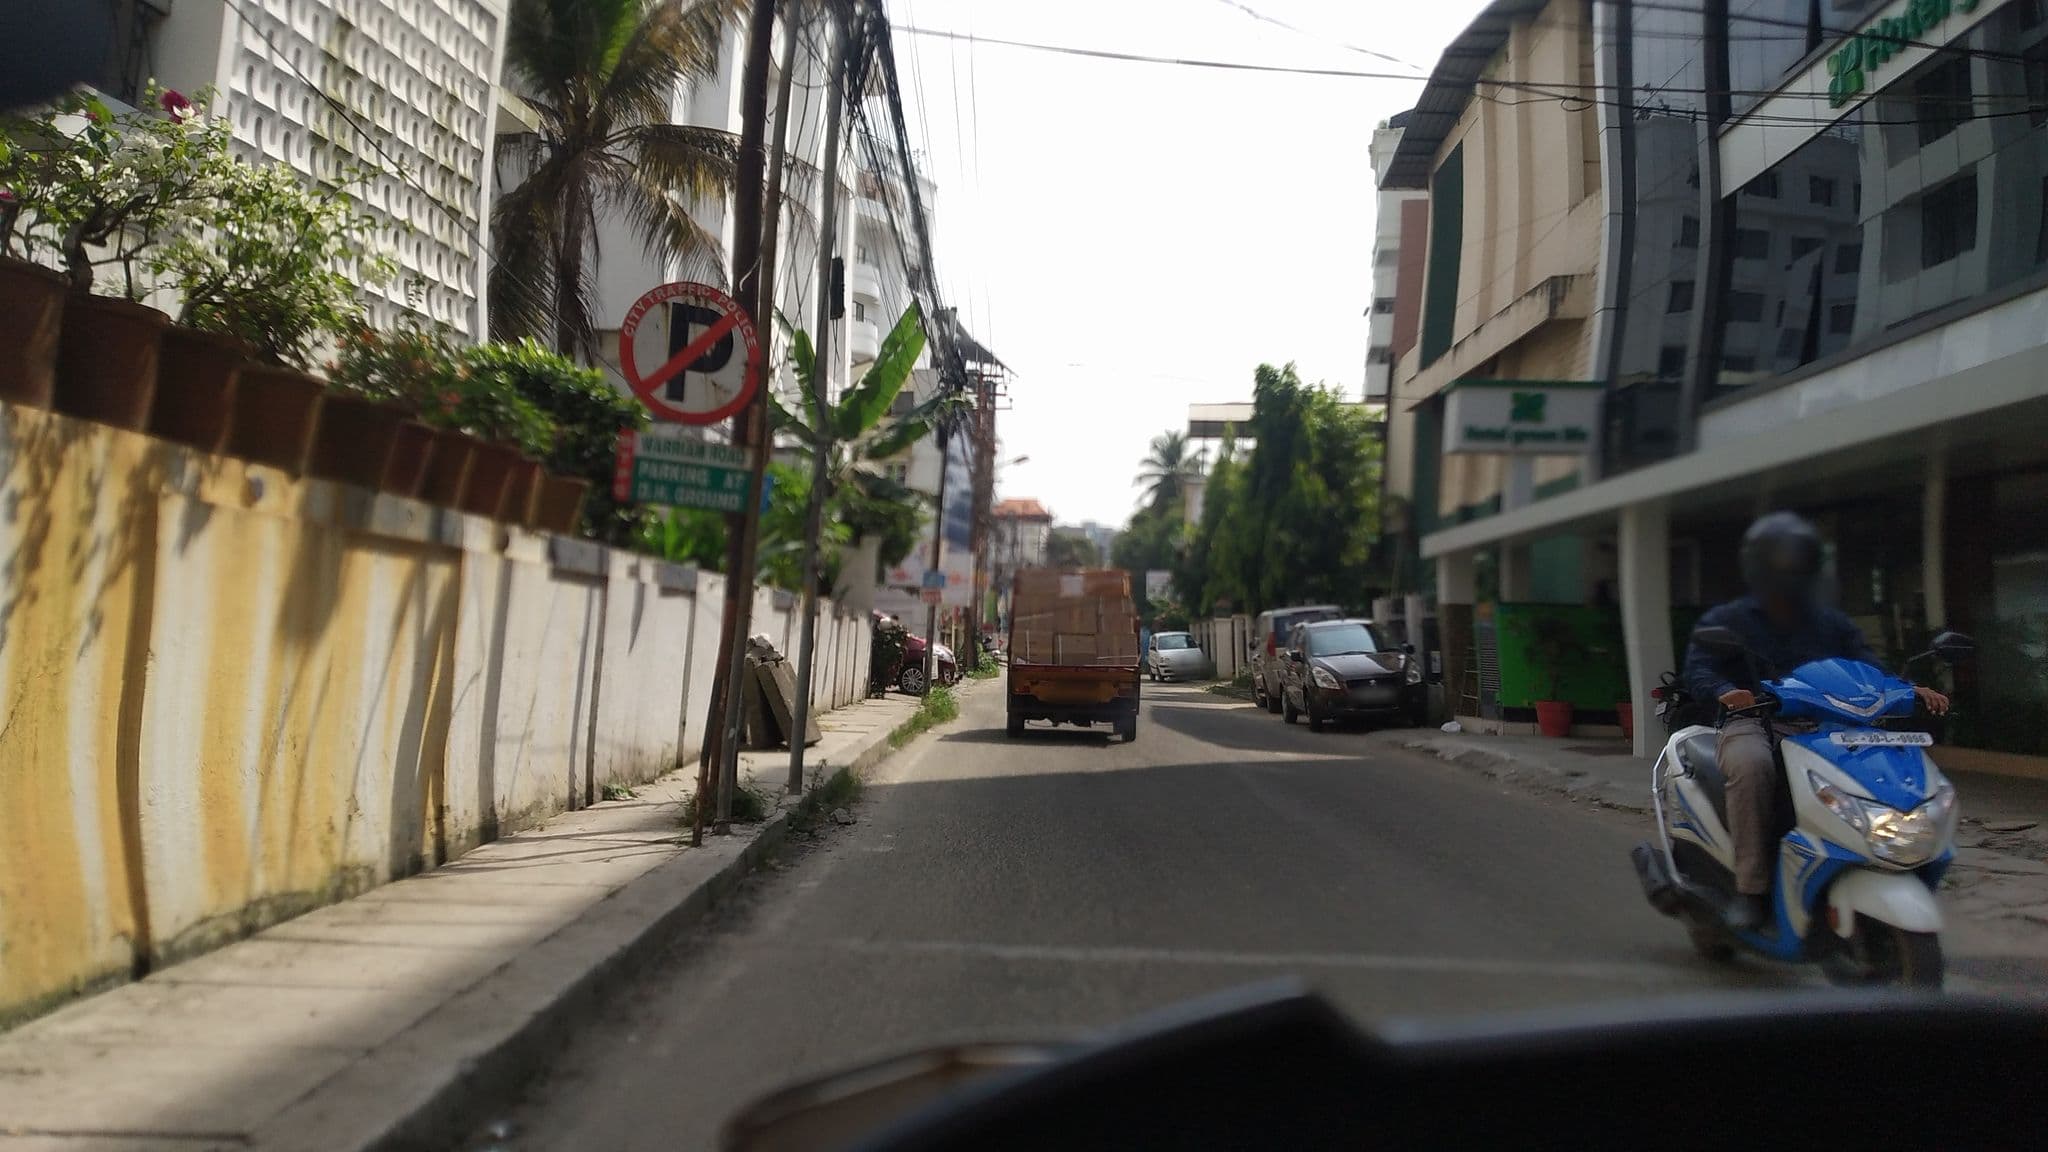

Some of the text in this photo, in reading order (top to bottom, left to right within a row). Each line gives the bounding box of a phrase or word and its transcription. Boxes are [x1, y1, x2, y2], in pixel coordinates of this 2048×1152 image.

[624, 284, 757, 349] CITY TRAFFIC POLICE
[666, 302, 734, 402] P
[637, 461, 745, 490] PARKING AT
[674, 487, 741, 511] GROUND
